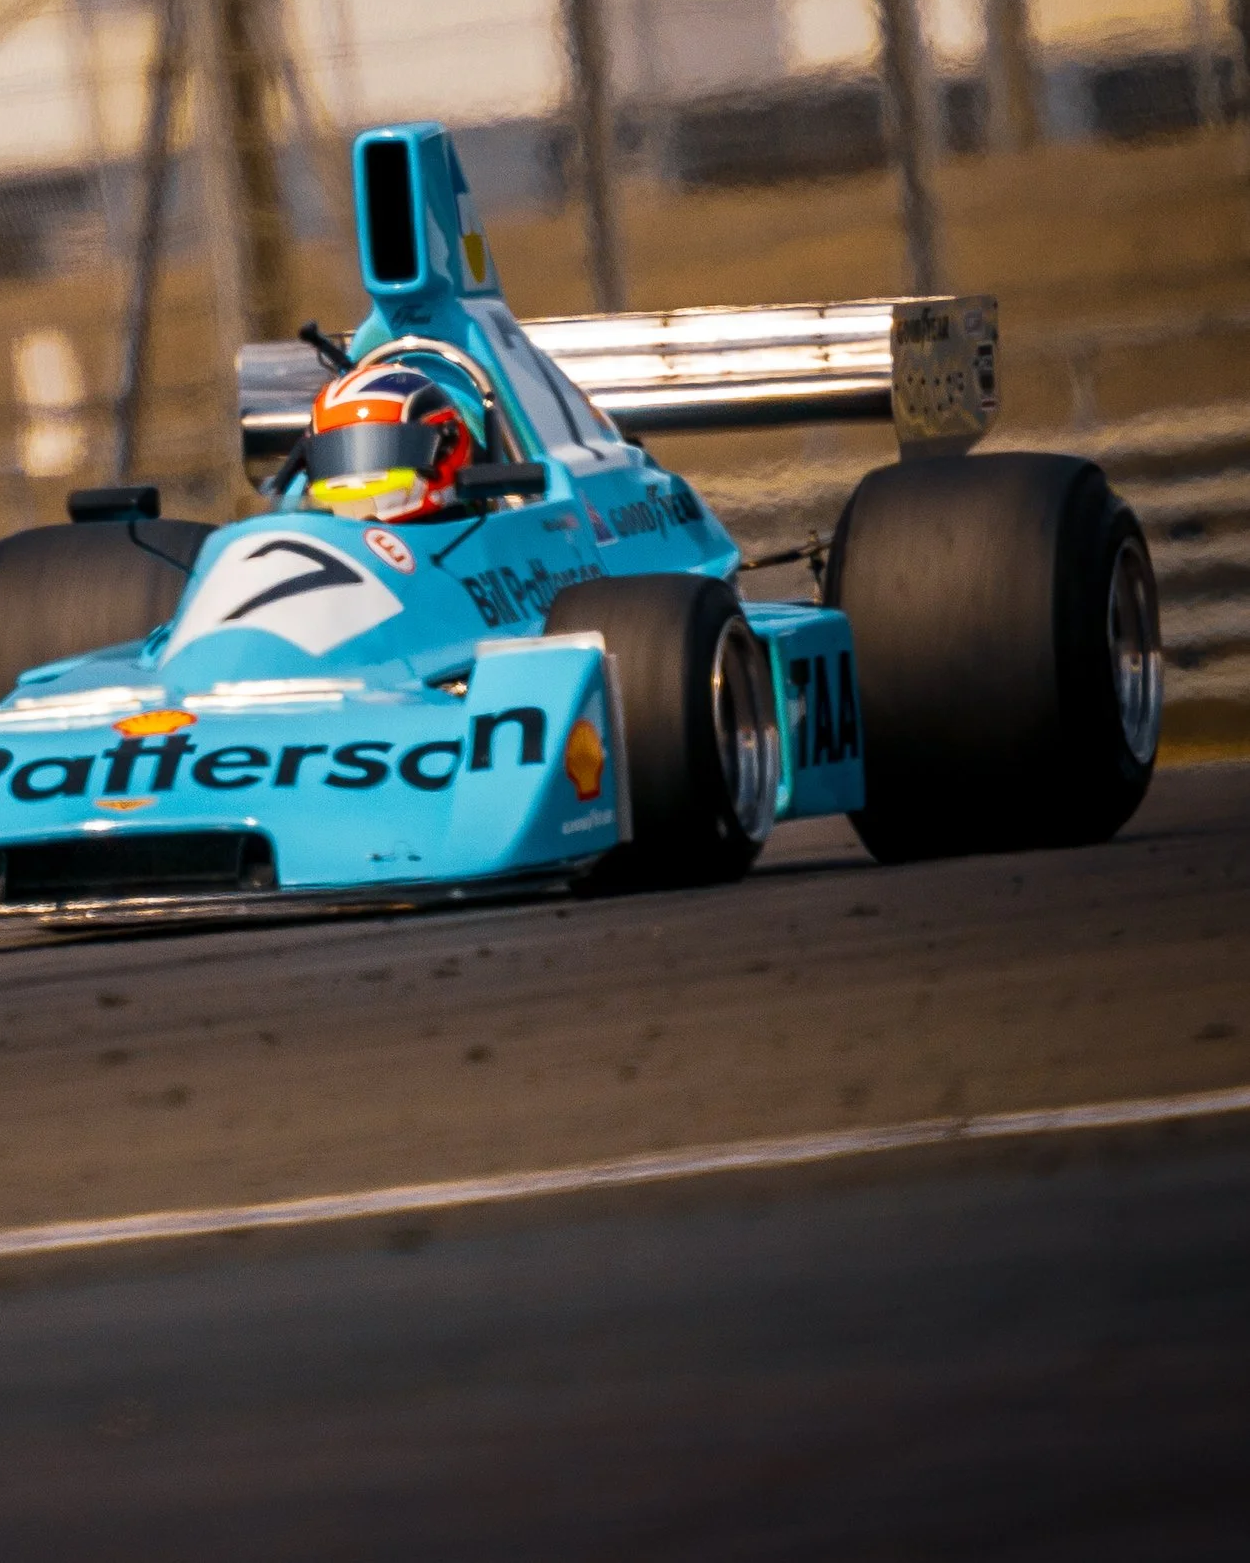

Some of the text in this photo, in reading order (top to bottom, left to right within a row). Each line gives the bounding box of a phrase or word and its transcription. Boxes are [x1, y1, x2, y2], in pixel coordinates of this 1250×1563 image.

[374, 534, 406, 563] E
[222, 539, 364, 622] 7
[461, 566, 521, 628] Bill
